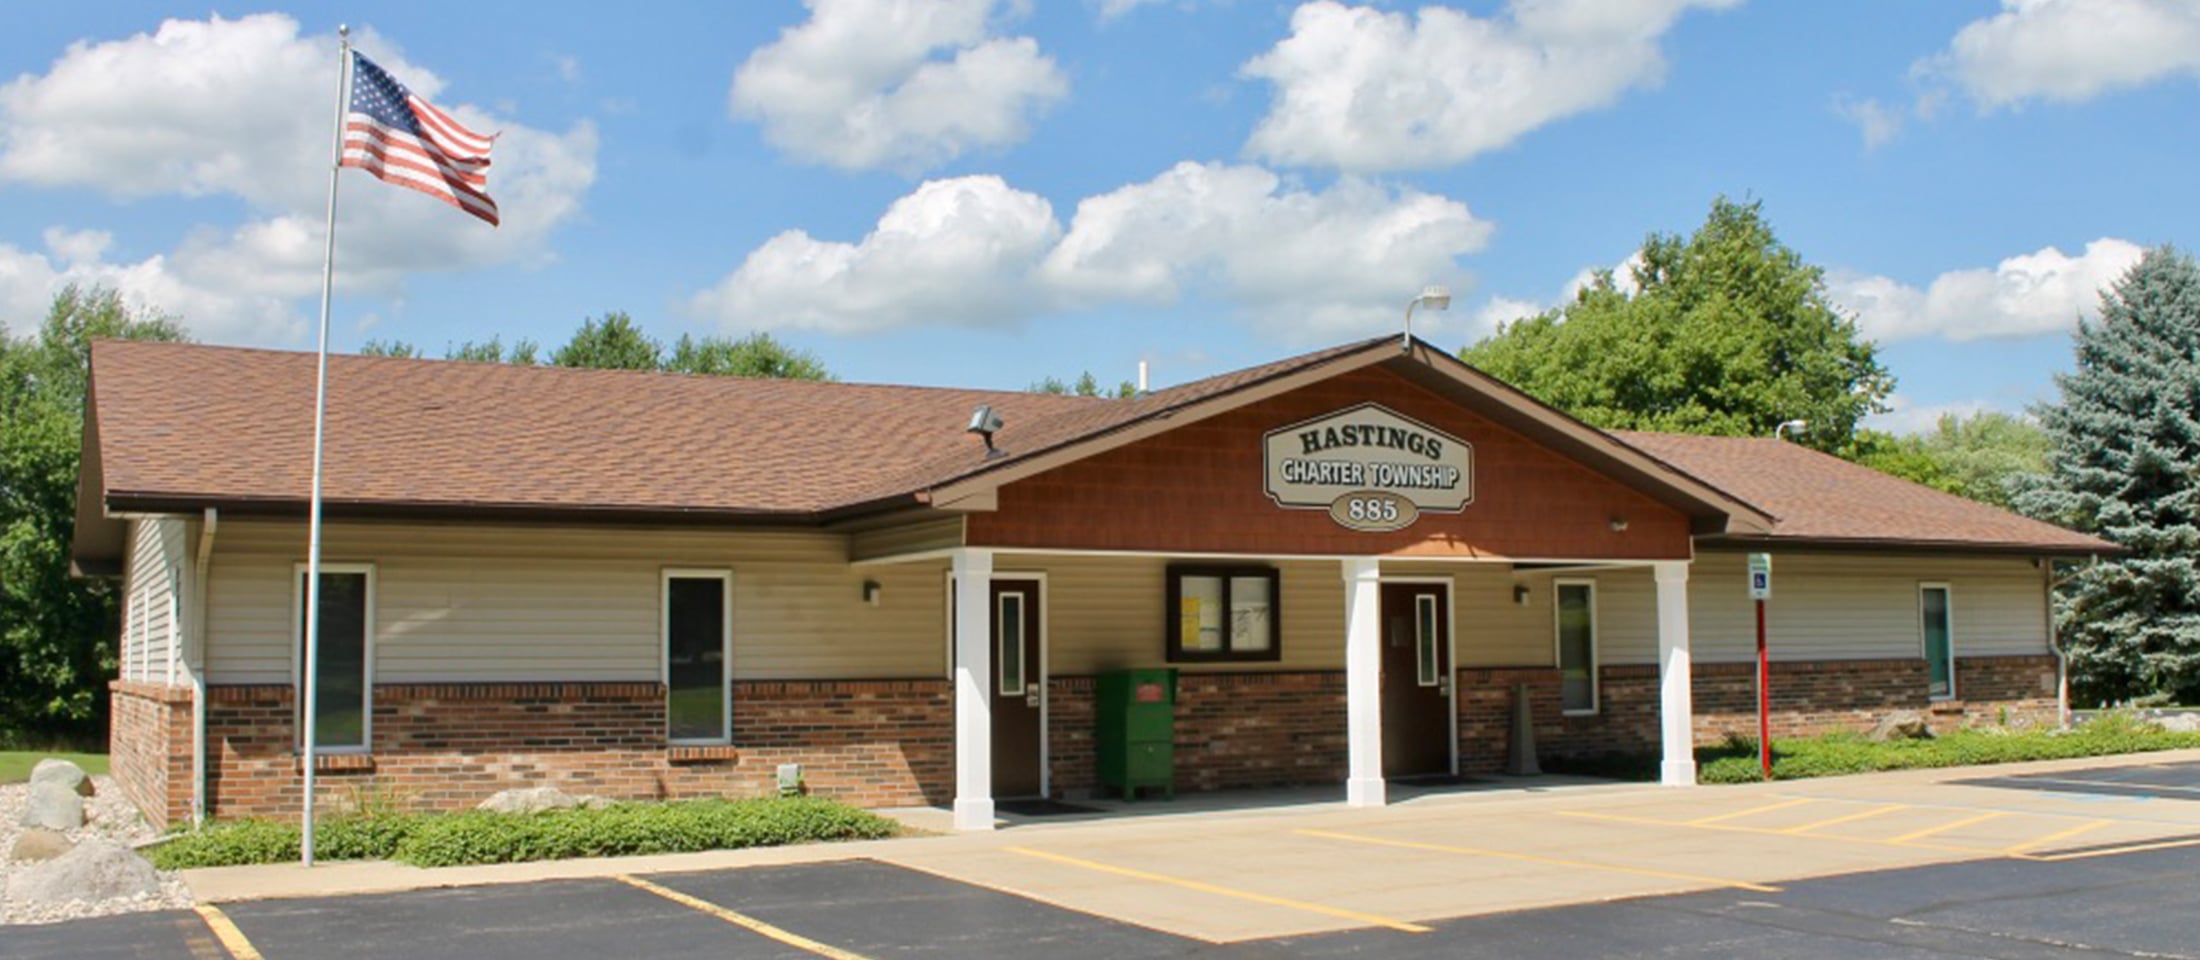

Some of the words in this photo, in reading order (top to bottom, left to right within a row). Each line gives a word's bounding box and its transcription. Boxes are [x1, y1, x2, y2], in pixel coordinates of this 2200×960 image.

[1299, 424, 1442, 460] HASTINGS
[1282, 459, 1365, 485] CHARTER
[1369, 462, 1459, 489] TOWNSHIP
[1348, 498, 1398, 521] 885
